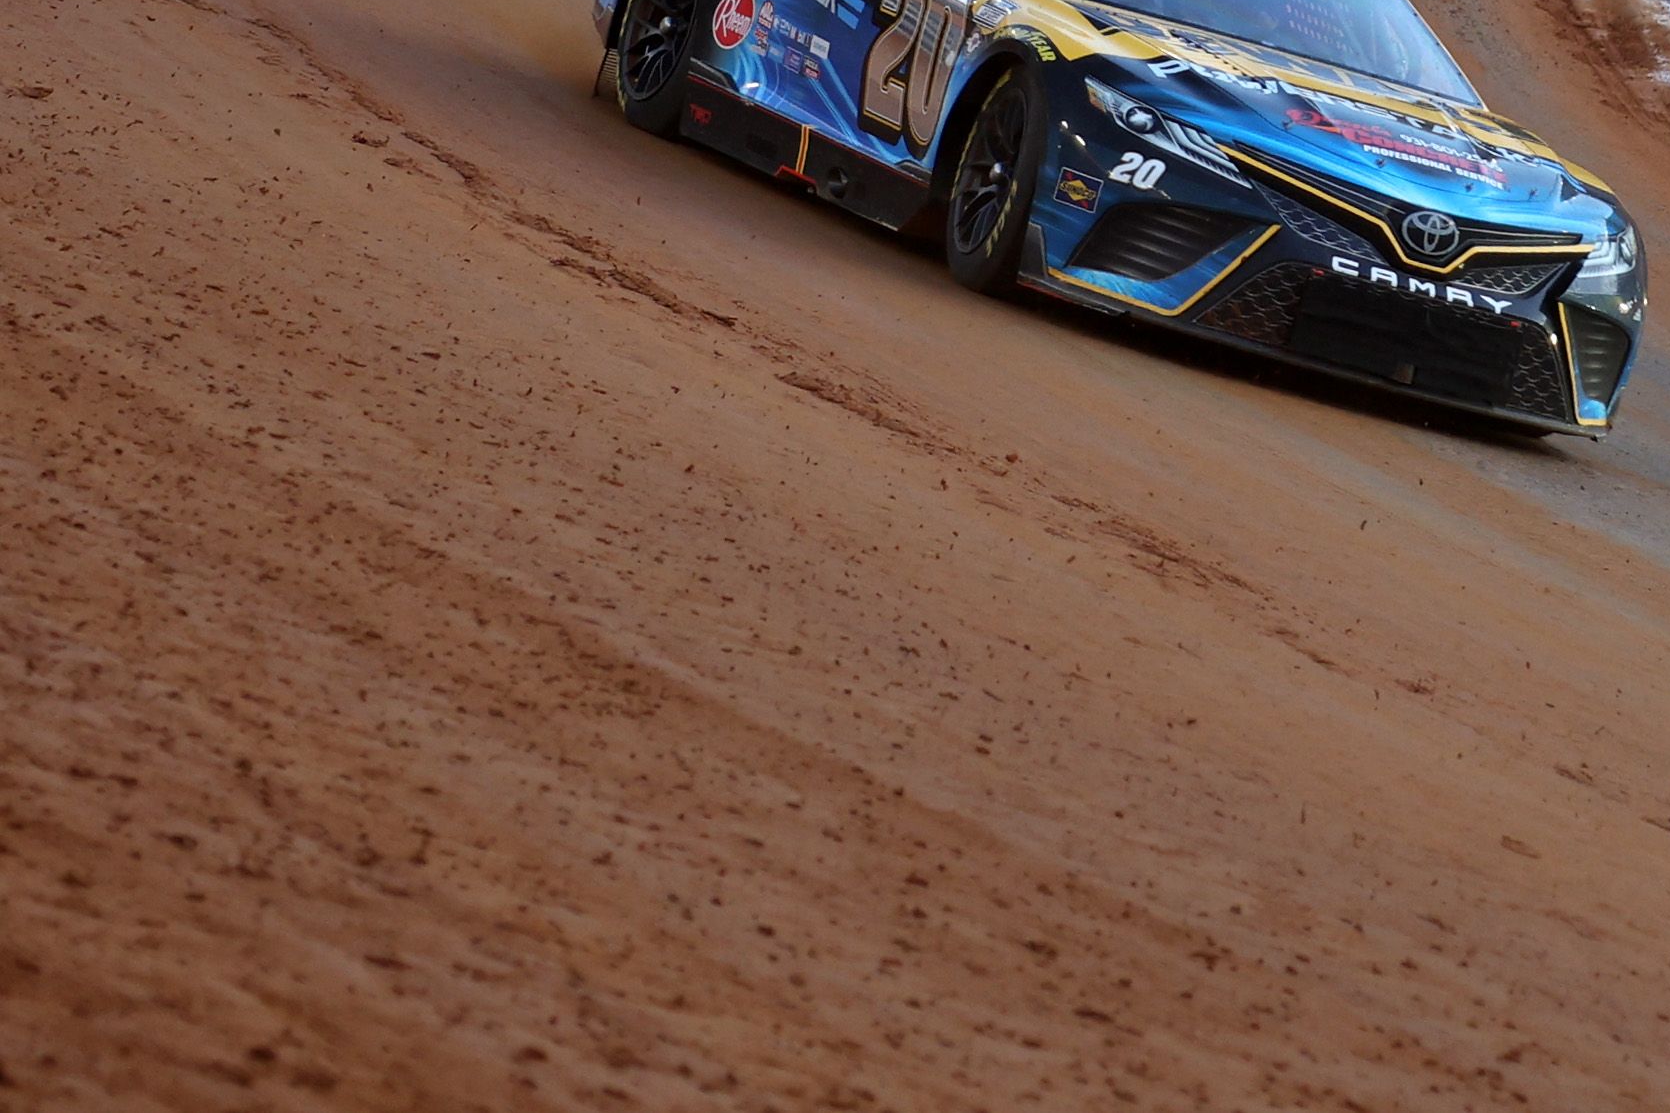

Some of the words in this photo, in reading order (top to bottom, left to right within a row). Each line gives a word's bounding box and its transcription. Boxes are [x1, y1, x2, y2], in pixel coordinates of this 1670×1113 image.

[1108, 151, 1166, 189] 20
[1363, 144, 1453, 173] PROFESSIONAL
[1455, 167, 1504, 190] SERVICE
[1331, 255, 1512, 314] CAMRY
